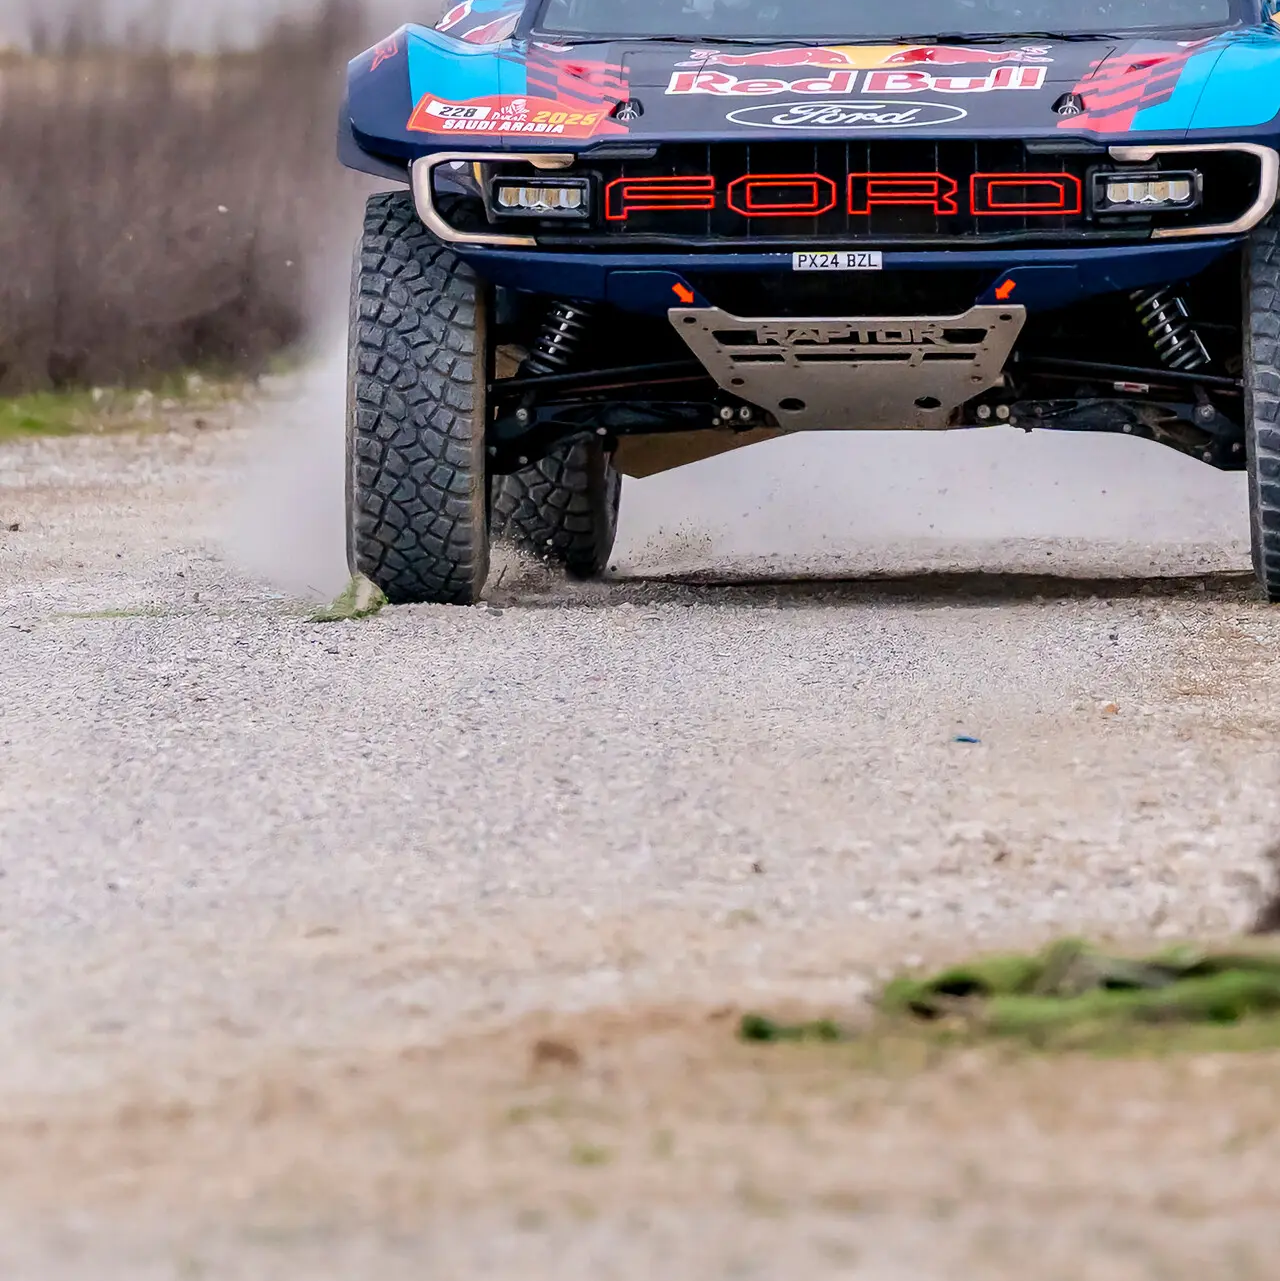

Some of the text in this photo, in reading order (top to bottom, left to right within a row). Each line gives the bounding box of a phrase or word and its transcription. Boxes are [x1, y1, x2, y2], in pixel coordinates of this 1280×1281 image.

[664, 66, 1049, 96] Red Bull
[438, 106, 478, 118] 228
[491, 111, 528, 122] DAKAR
[532, 111, 597, 126] 2025
[772, 102, 922, 126] Ford
[442, 119, 566, 134] SAUDI ARABIA
[605, 172, 1083, 220] FORD
[797, 253, 878, 268] PX24 BZL
[755, 326, 946, 347] RAPTOR
